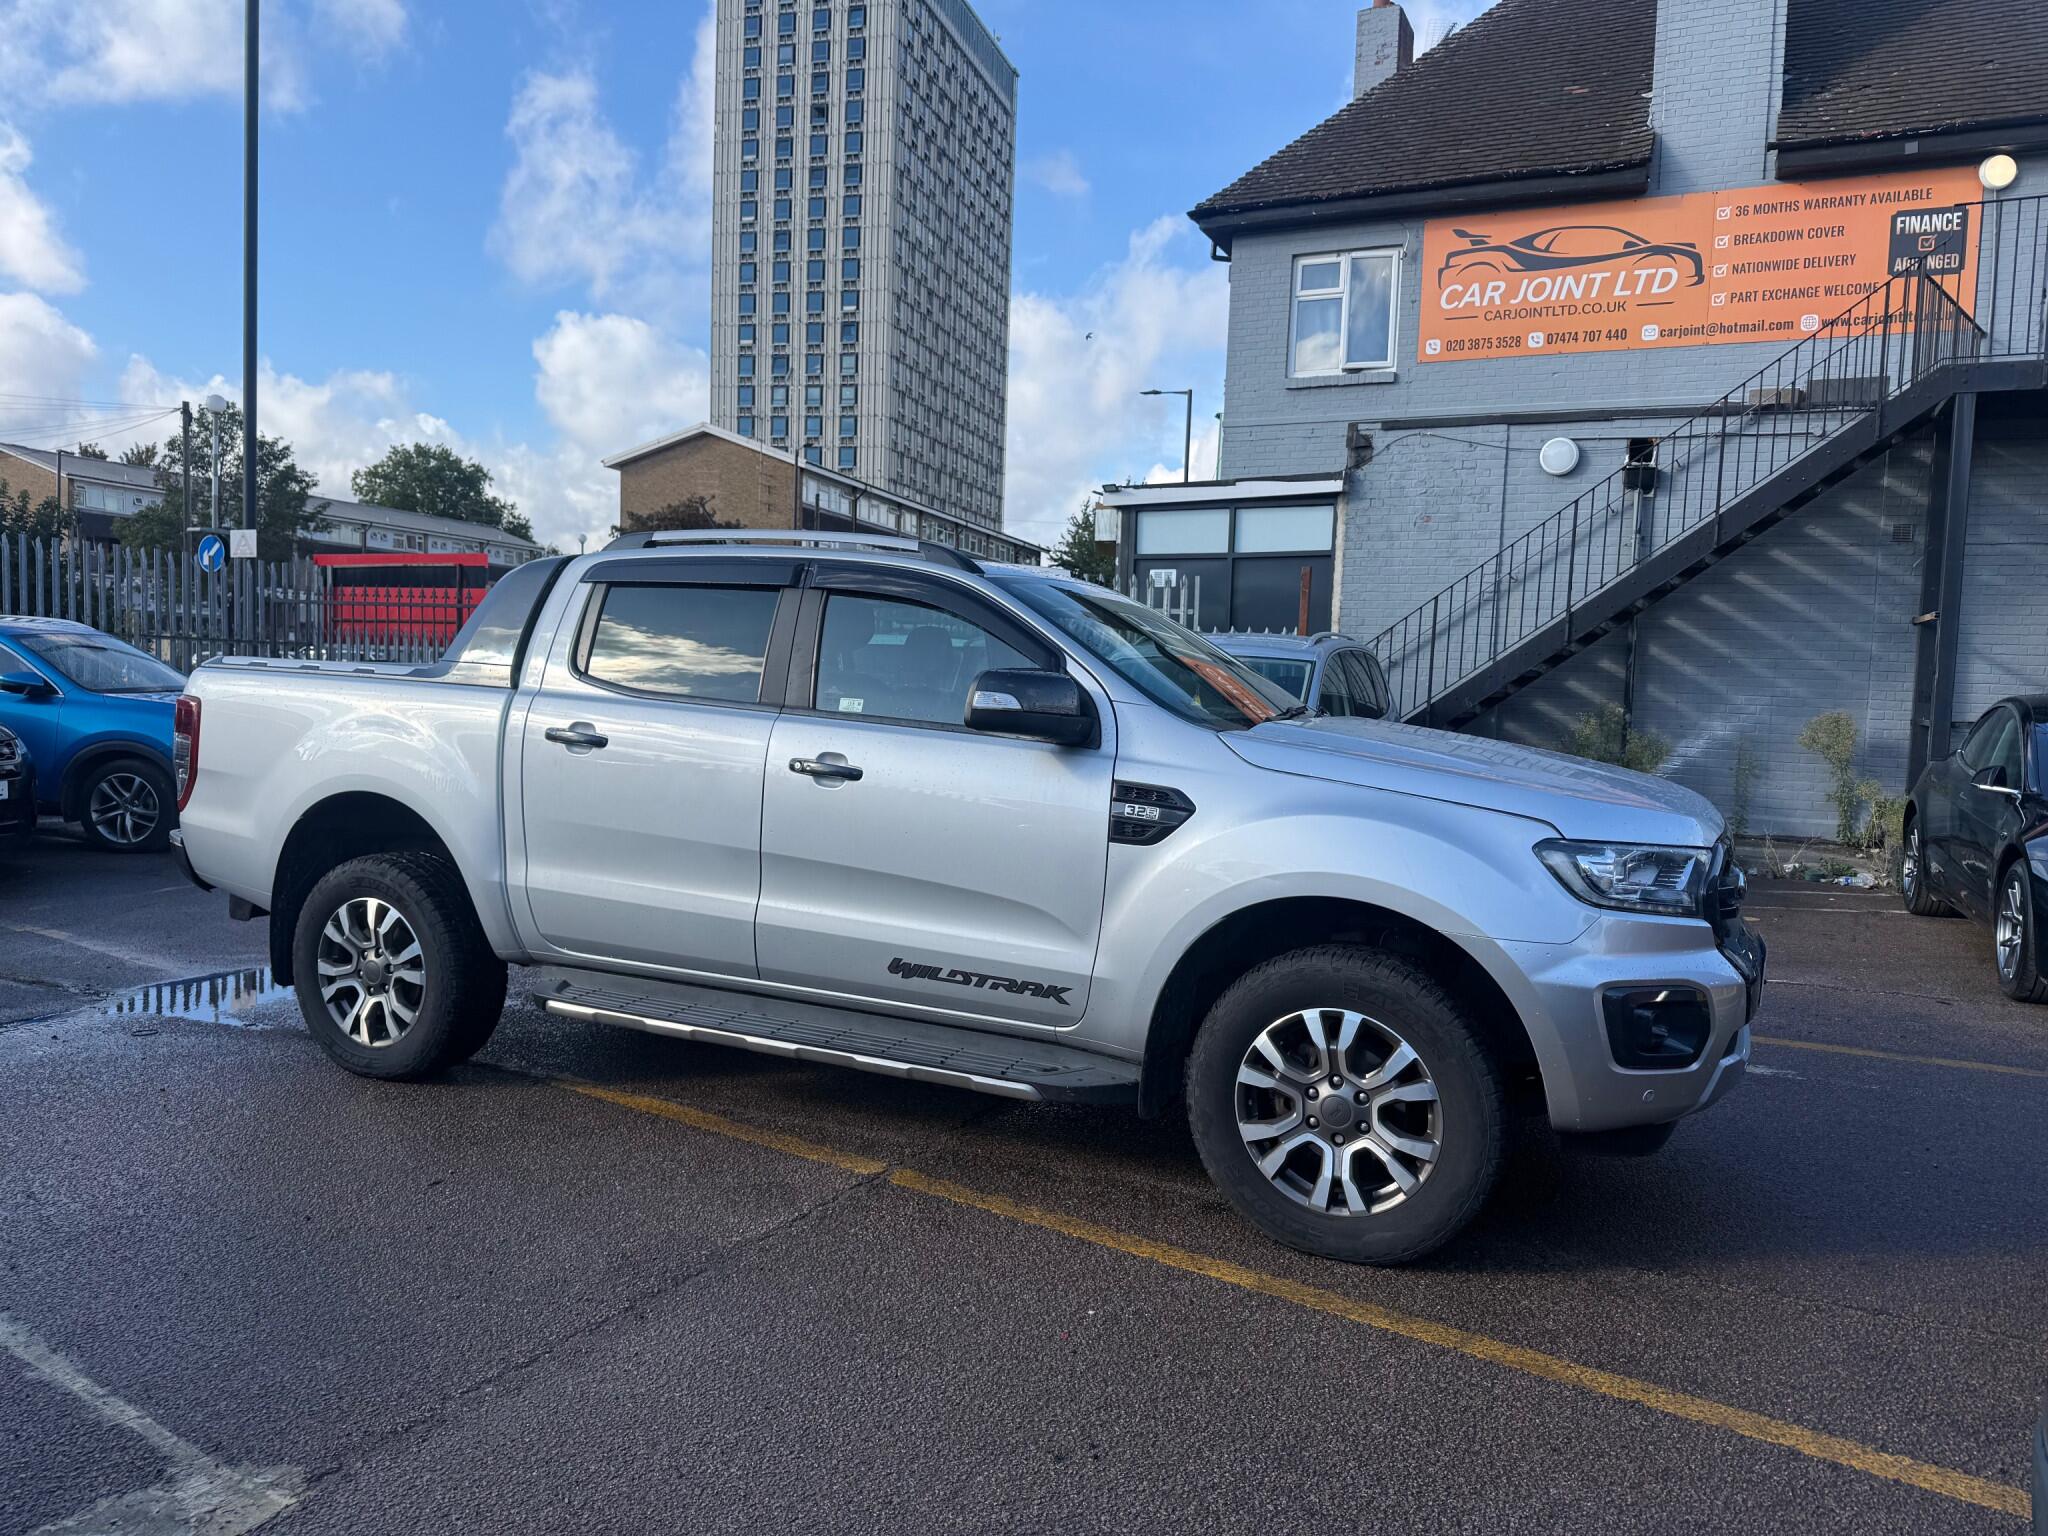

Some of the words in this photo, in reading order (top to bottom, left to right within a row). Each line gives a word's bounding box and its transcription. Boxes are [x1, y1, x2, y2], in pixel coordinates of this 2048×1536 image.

[1735, 205, 1750, 218] 36
[1753, 200, 1800, 215] MONTHS
[1803, 194, 1867, 211] WARRANTY
[1870, 188, 1933, 206] AVAILABLE
[1896, 212, 1962, 235] FINANCE
[1733, 228, 1804, 246] BREAKDOWN
[1807, 225, 1845, 240] COVER
[1731, 257, 1800, 275] NATIONWIDE
[1803, 254, 1857, 269] DELIVERY
[1440, 281, 1505, 310] CAR
[1510, 272, 1610, 305] JOINT
[1613, 267, 1678, 296] LTD
[1730, 290, 1759, 304] PART
[1762, 285, 1820, 302] EXCHANGE
[1824, 282, 1880, 298] WELCOME
[1484, 301, 1627, 322] CARJOINTLTD.CO.UK
[1546, 331, 1579, 345] 07474
[1582, 330, 1602, 343] 707
[1605, 328, 1627, 341] 440
[1660, 319, 1794, 339] carjoint@hotmail.com
[1446, 339, 1465, 352] 020
[1467, 336, 1494, 351] 3875
[1495, 335, 1522, 349] 3528
[887, 957, 1073, 1006] WILDTRAK
